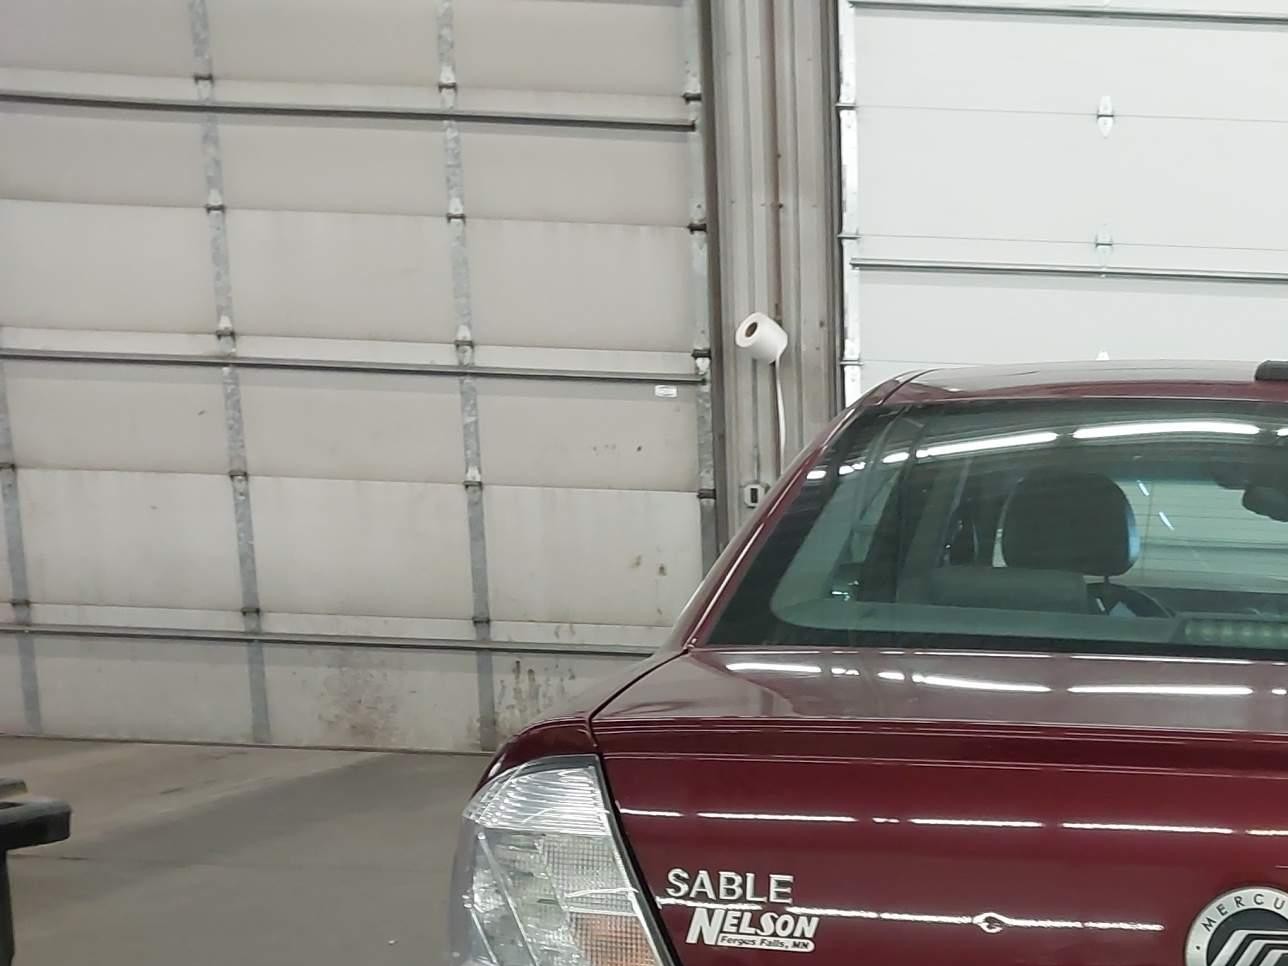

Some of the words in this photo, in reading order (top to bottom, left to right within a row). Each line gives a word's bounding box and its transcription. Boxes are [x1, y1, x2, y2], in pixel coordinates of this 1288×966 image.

[666, 868, 794, 905] SABLE
[686, 907, 820, 946] NELSON
[720, 935, 756, 946] Fergus
